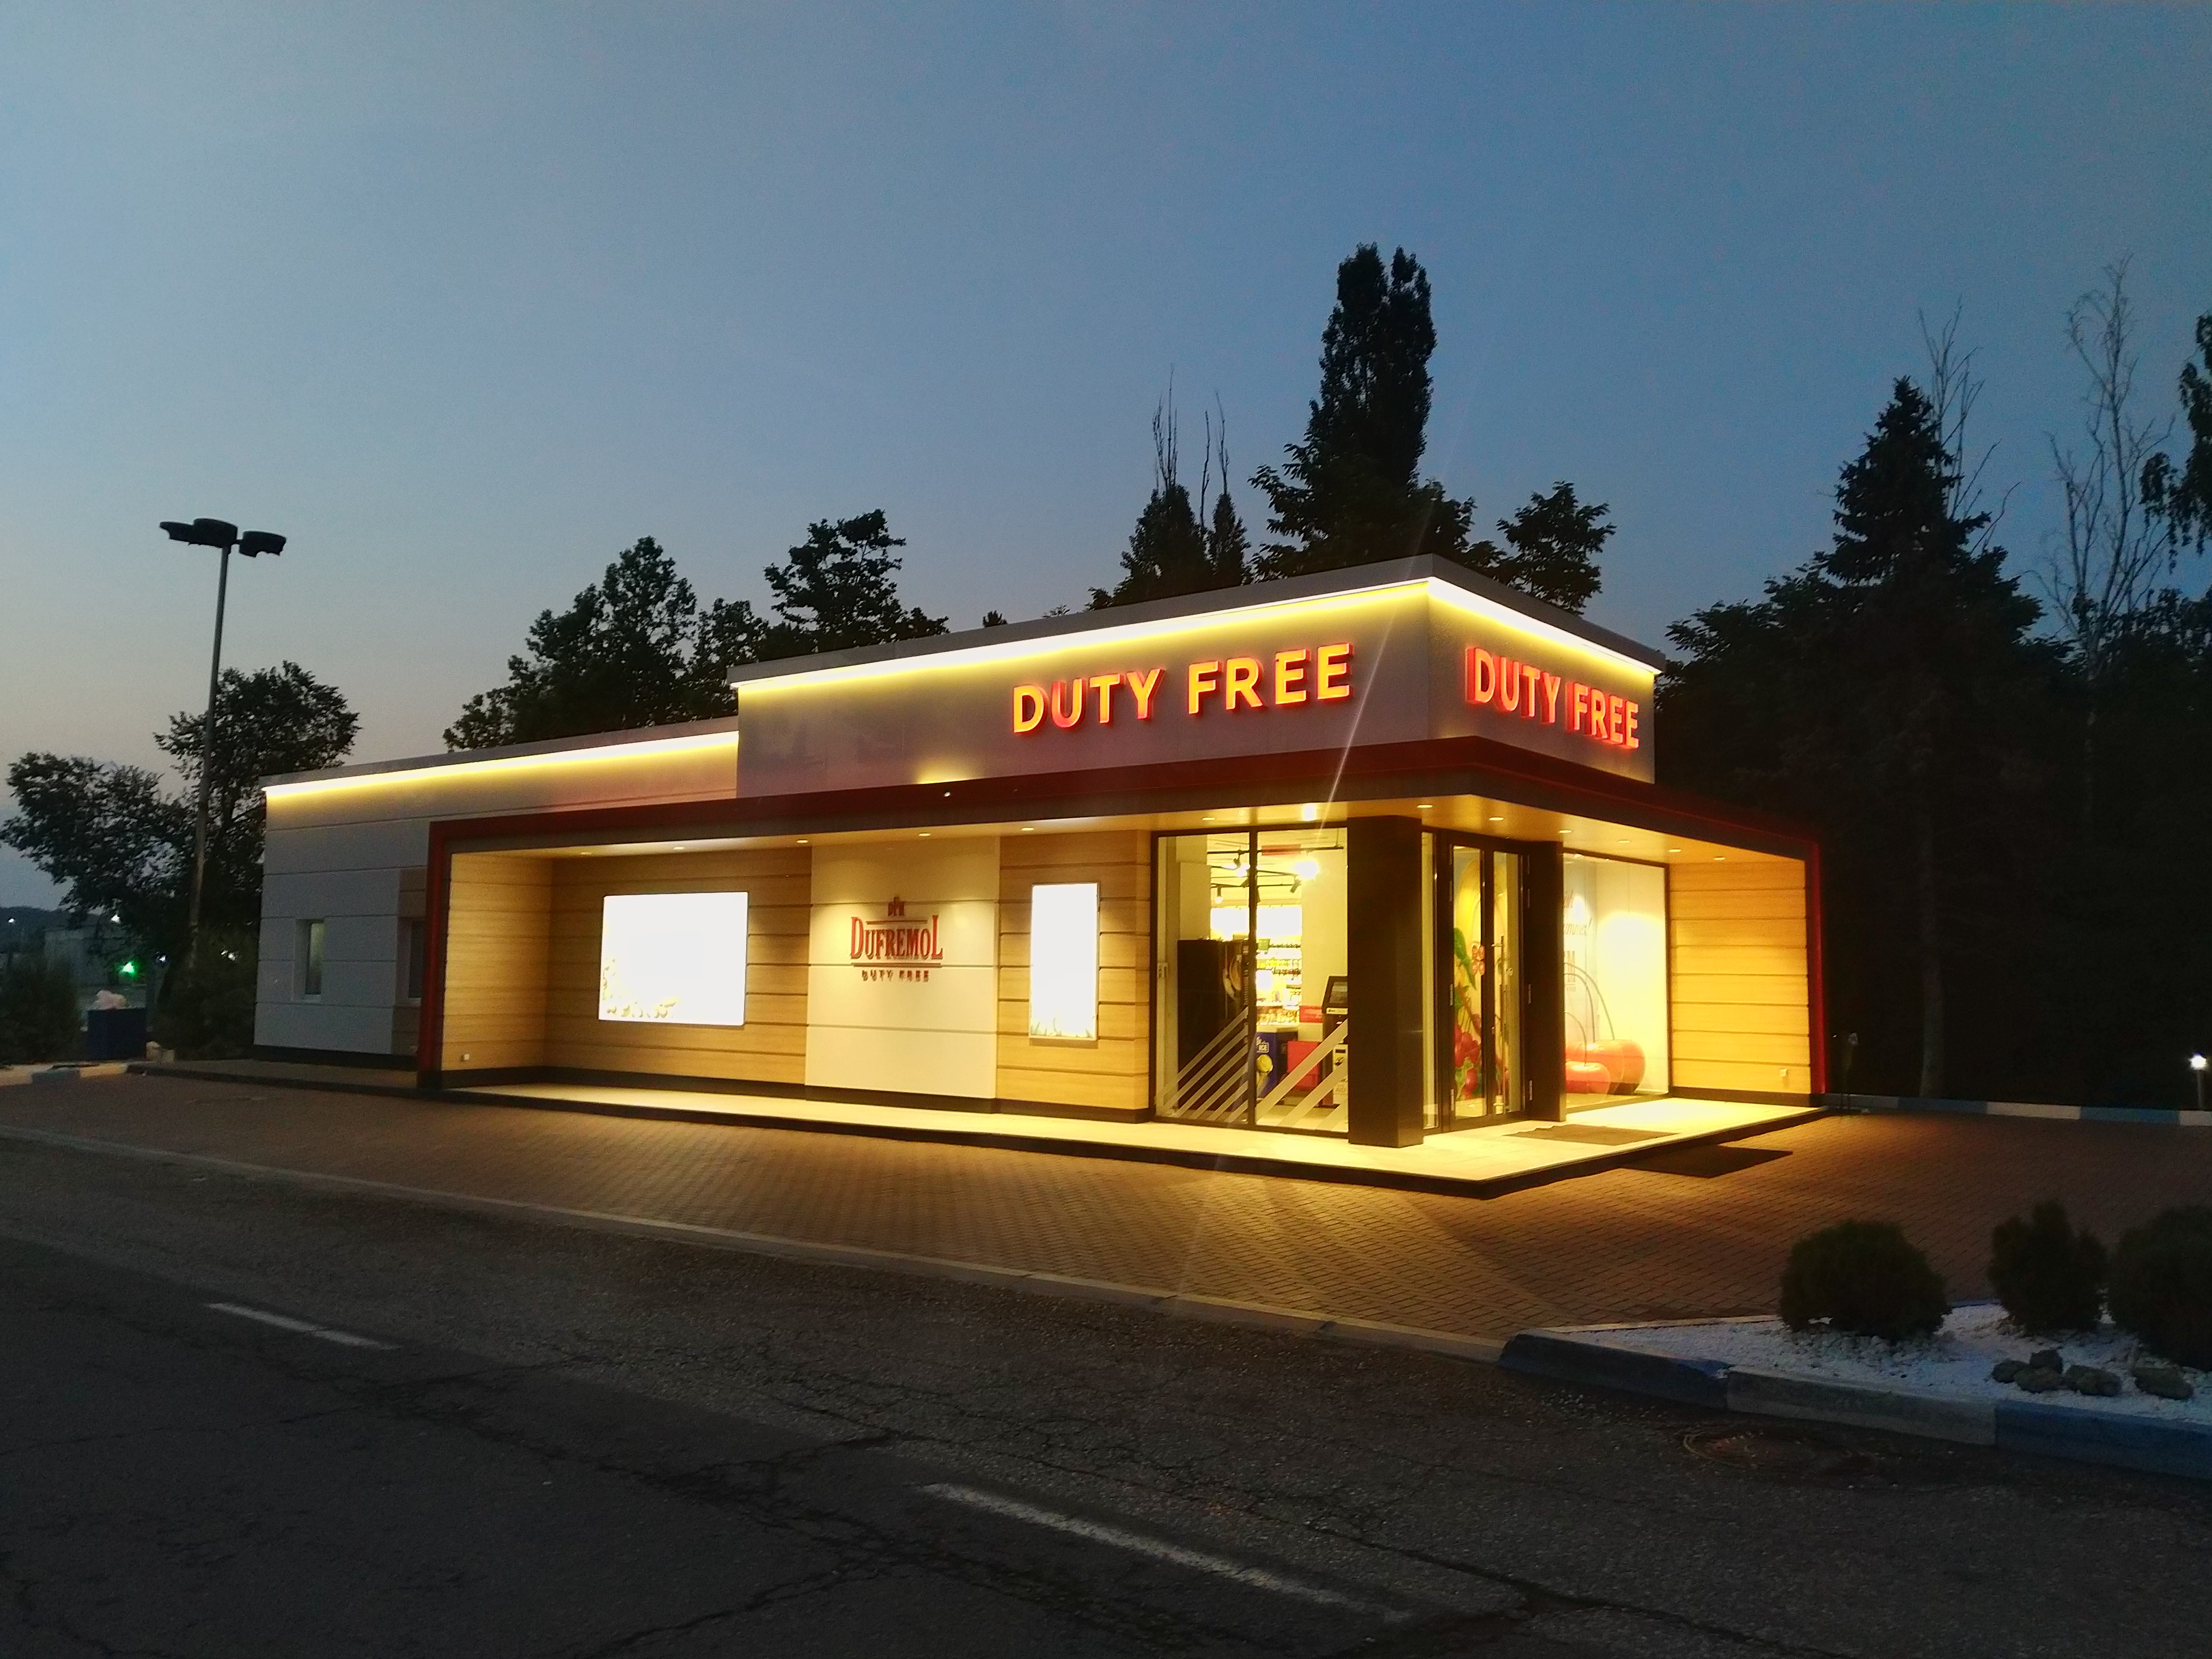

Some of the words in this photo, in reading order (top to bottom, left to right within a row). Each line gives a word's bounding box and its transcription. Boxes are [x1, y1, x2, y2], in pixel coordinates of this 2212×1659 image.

[1013, 668, 1165, 733] DUTY
[1188, 643, 1353, 714] FREE
[1465, 647, 1561, 724] DUTY
[1565, 682, 1639, 749] FREE
[862, 969, 892, 980] DUTY
[899, 970, 929, 981] FREE
